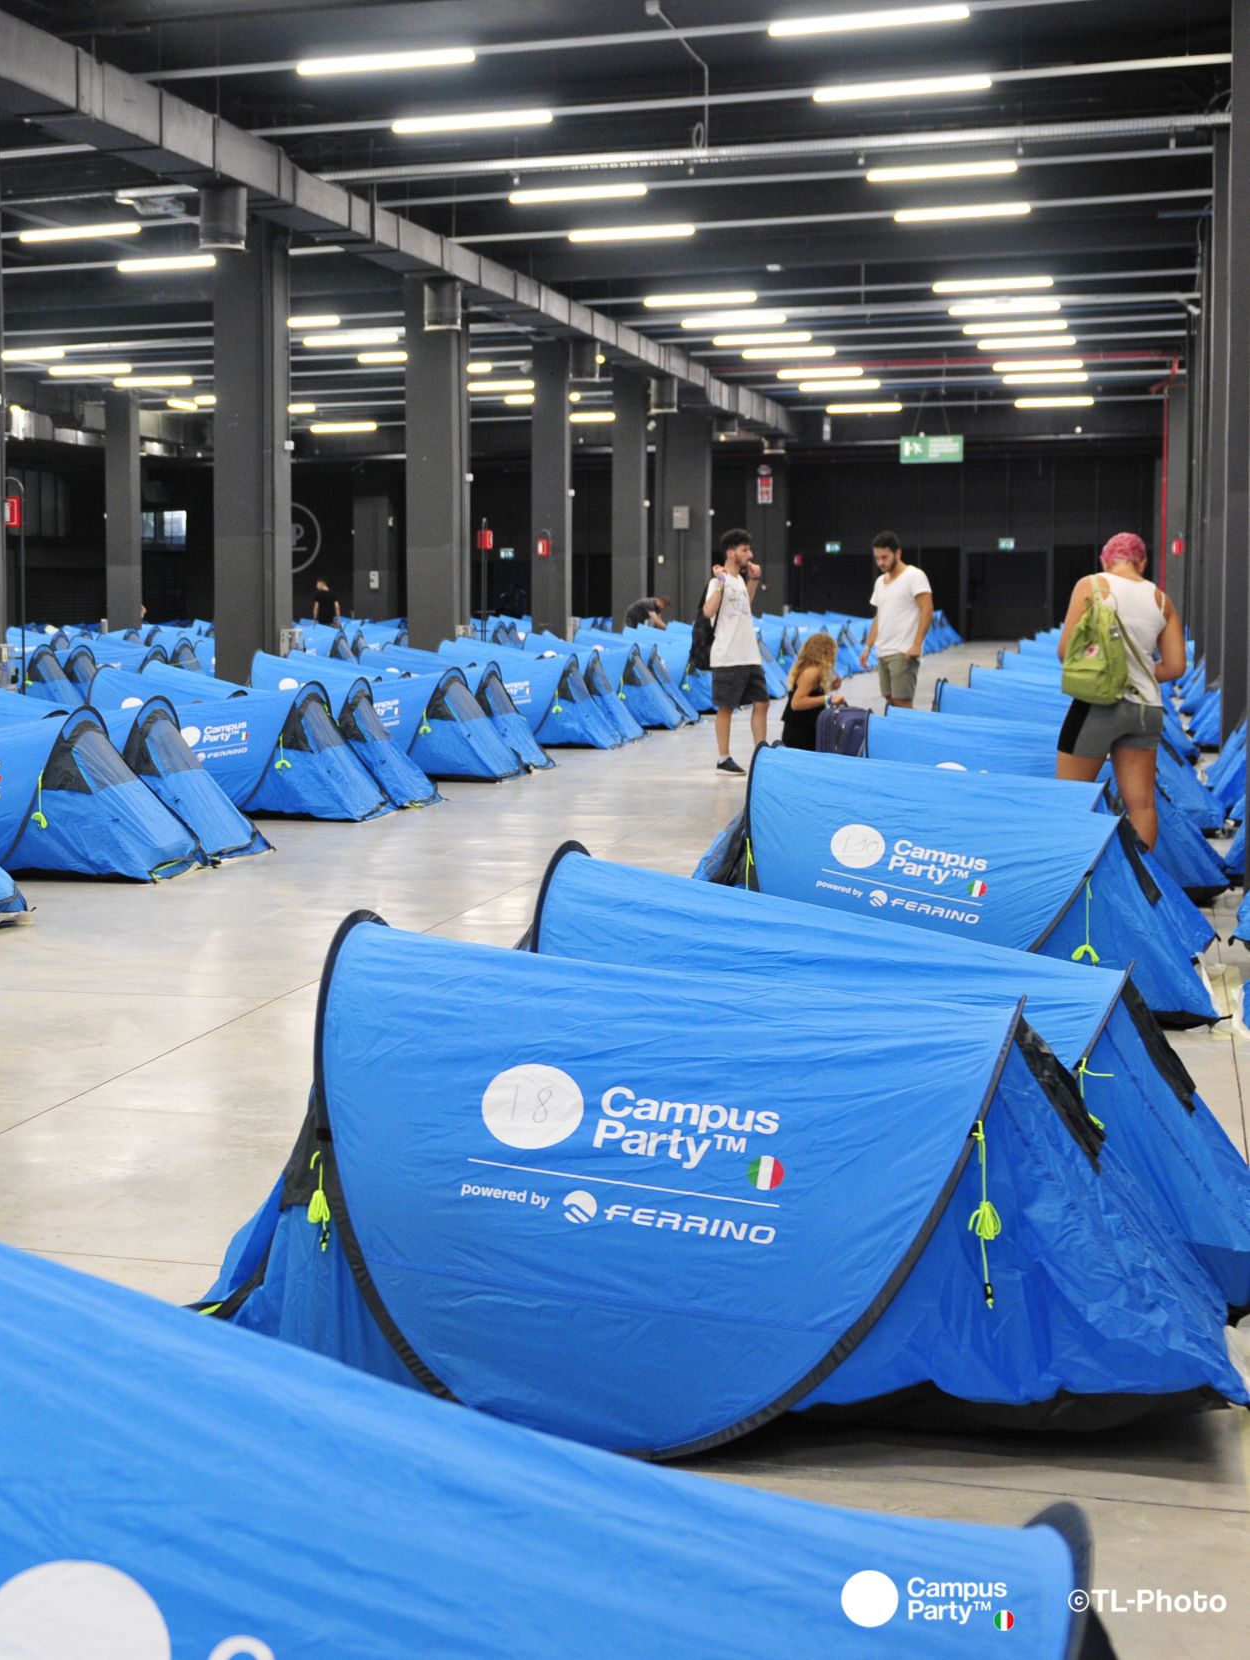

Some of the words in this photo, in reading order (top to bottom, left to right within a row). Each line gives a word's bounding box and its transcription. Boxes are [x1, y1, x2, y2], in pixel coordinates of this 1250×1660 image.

[203, 721, 248, 736] Campus
[893, 839, 988, 872] Campus
[815, 880, 852, 895] powered
[852, 886, 864, 898] by
[890, 897, 980, 925] FERRINO
[600, 1086, 780, 1135] Campus
[460, 1182, 528, 1205] powered
[528, 1191, 550, 1210] by
[603, 1203, 777, 1246] FERRINO
